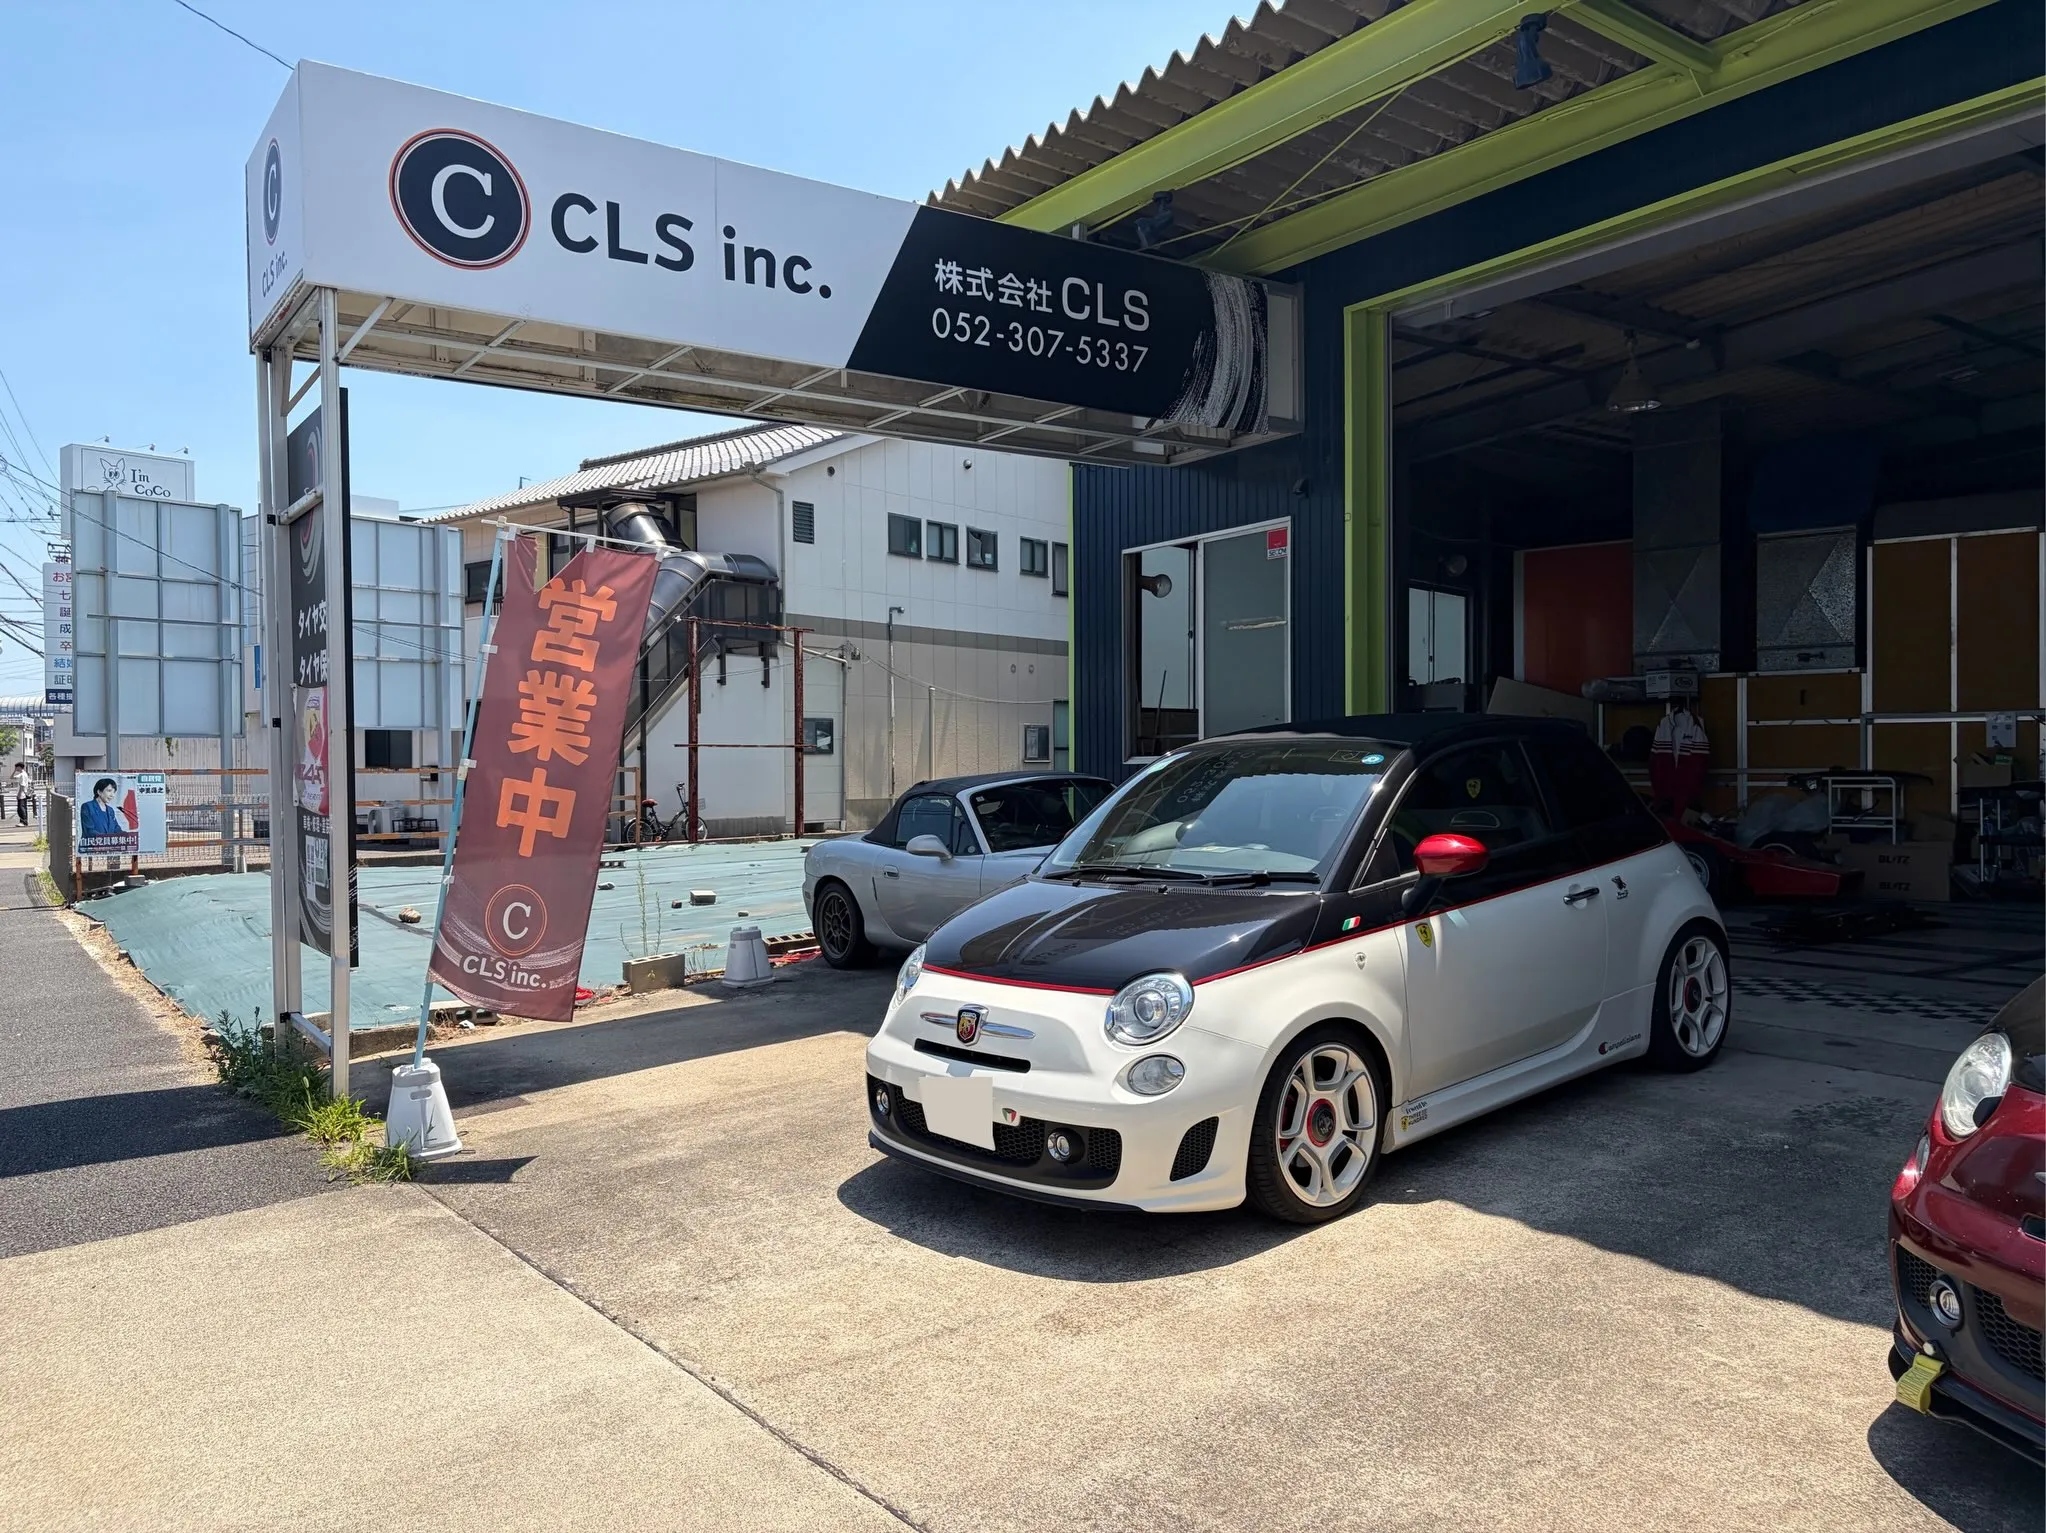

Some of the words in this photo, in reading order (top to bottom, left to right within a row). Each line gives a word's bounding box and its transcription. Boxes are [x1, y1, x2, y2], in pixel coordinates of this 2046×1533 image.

[268, 162, 278, 221] C
[431, 164, 495, 239] C
[262, 259, 275, 298] CLS
[275, 250, 288, 280] inc.
[550, 192, 695, 272] CLS
[723, 225, 832, 299] inc.
[933, 257, 1053, 314] 株式会社
[1061, 276, 1150, 332] CLS
[931, 307, 1150, 373] 052-307-5337
[60, 624, 72, 634] 成
[496, 577, 618, 858] 営業中
[502, 901, 532, 941] C
[461, 954, 507, 980] CLS
[510, 963, 547, 989] inc.
